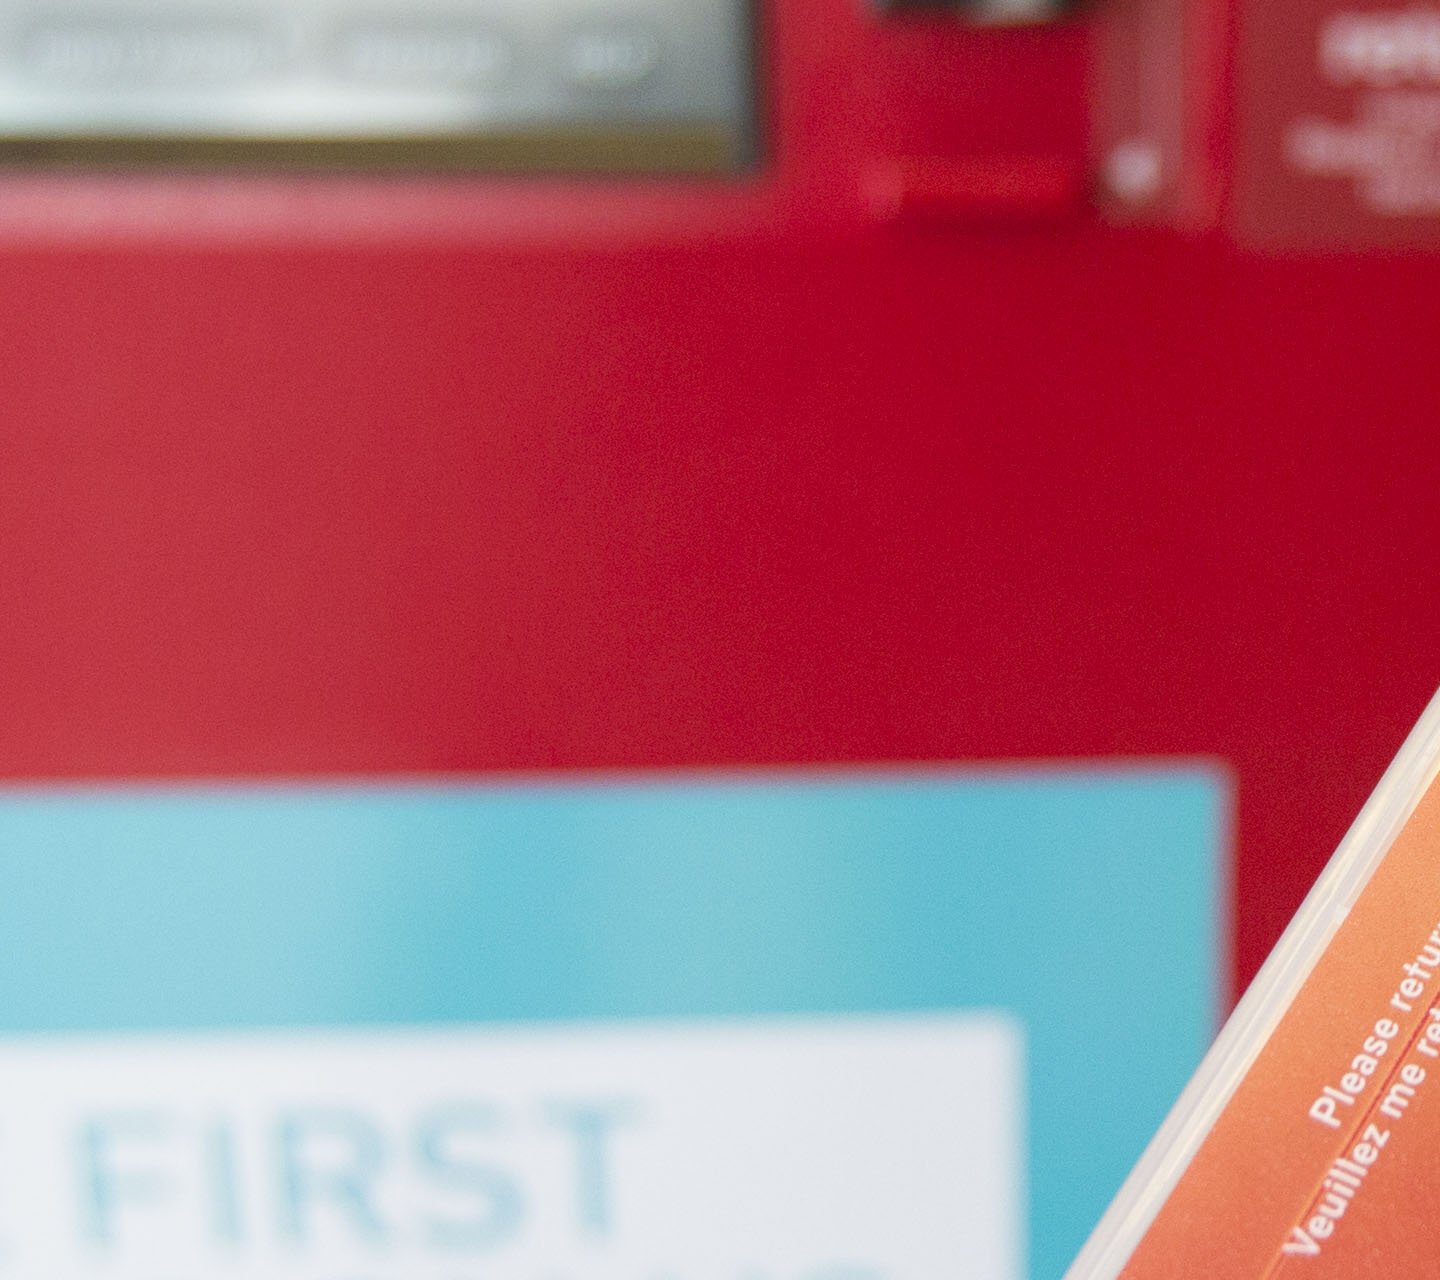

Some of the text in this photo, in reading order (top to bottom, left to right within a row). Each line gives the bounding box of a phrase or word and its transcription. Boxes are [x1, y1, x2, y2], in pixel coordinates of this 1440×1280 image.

[1309, 1019, 1399, 1128] Please
[74, 1100, 645, 1254] FIRST
[1282, 1124, 1390, 1255] Veuillez
[1380, 1064, 1426, 1118] me
